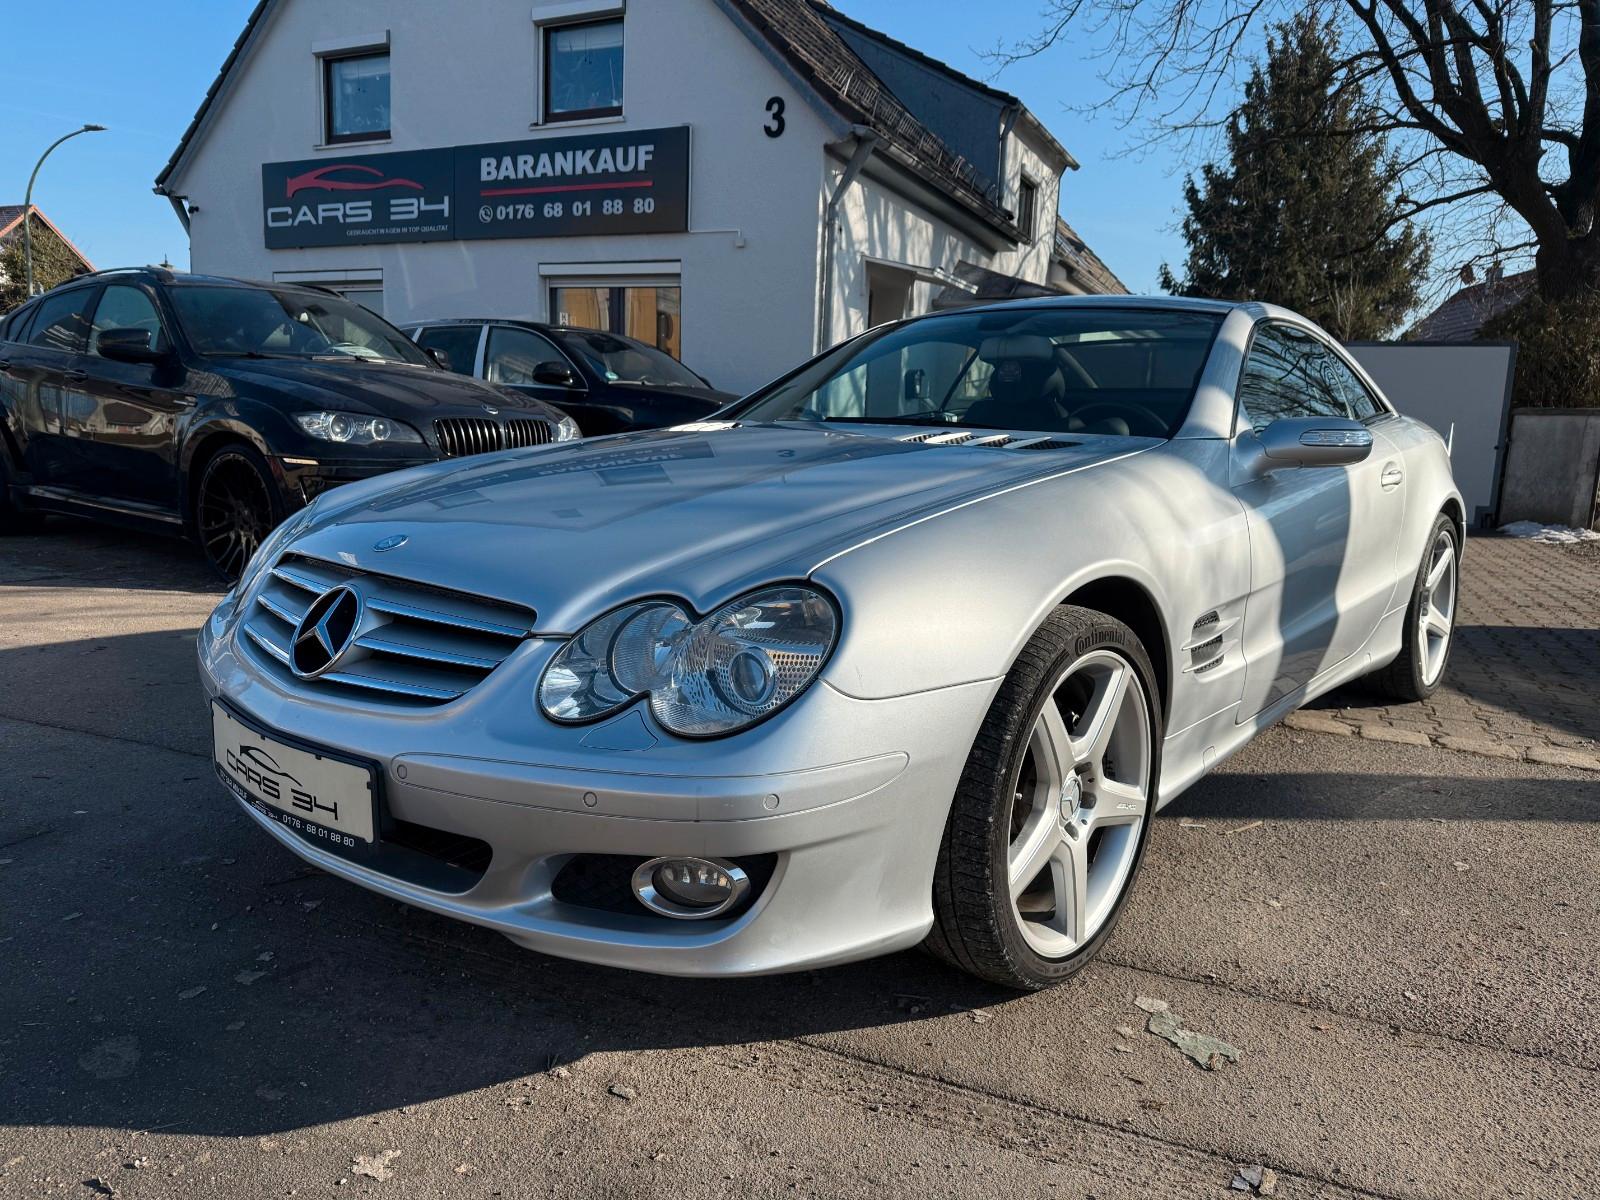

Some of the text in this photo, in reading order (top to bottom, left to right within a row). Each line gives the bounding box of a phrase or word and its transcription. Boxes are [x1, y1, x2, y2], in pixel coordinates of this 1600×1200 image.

[763, 96, 786, 139] 3
[480, 145, 654, 181] BARANKAUF
[266, 196, 450, 228] CARS 34
[496, 197, 656, 221] 0176 68 01 88 80
[1074, 628, 1126, 657] Continental
[227, 749, 280, 799] CARS
[291, 788, 338, 820] 34
[282, 814, 301, 829] 0176
[306, 824, 317, 835] 68
[318, 828, 328, 838] 01
[330, 832, 341, 843] 88
[343, 836, 355, 847] 80
